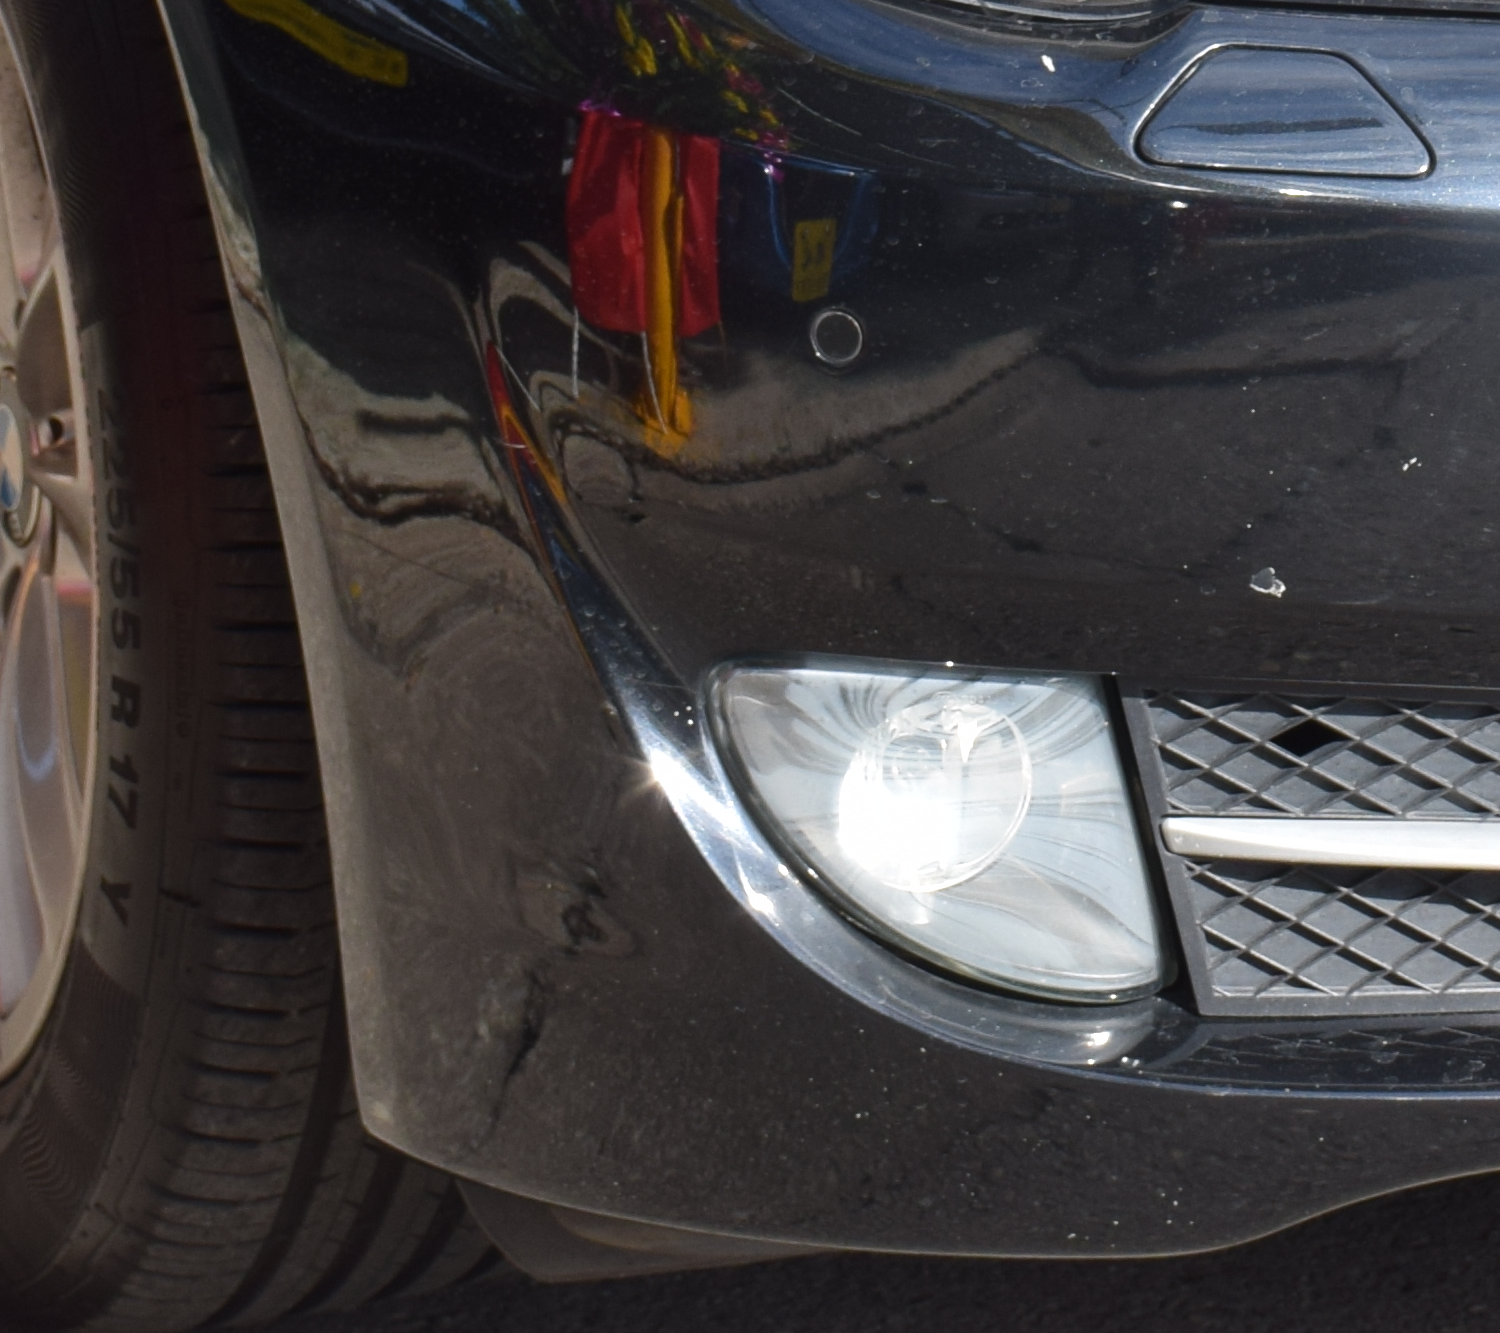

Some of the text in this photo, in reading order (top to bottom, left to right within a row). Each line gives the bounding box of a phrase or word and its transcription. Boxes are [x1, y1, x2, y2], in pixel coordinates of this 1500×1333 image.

[97, 389, 142, 928] 225/55 R 17 Y
